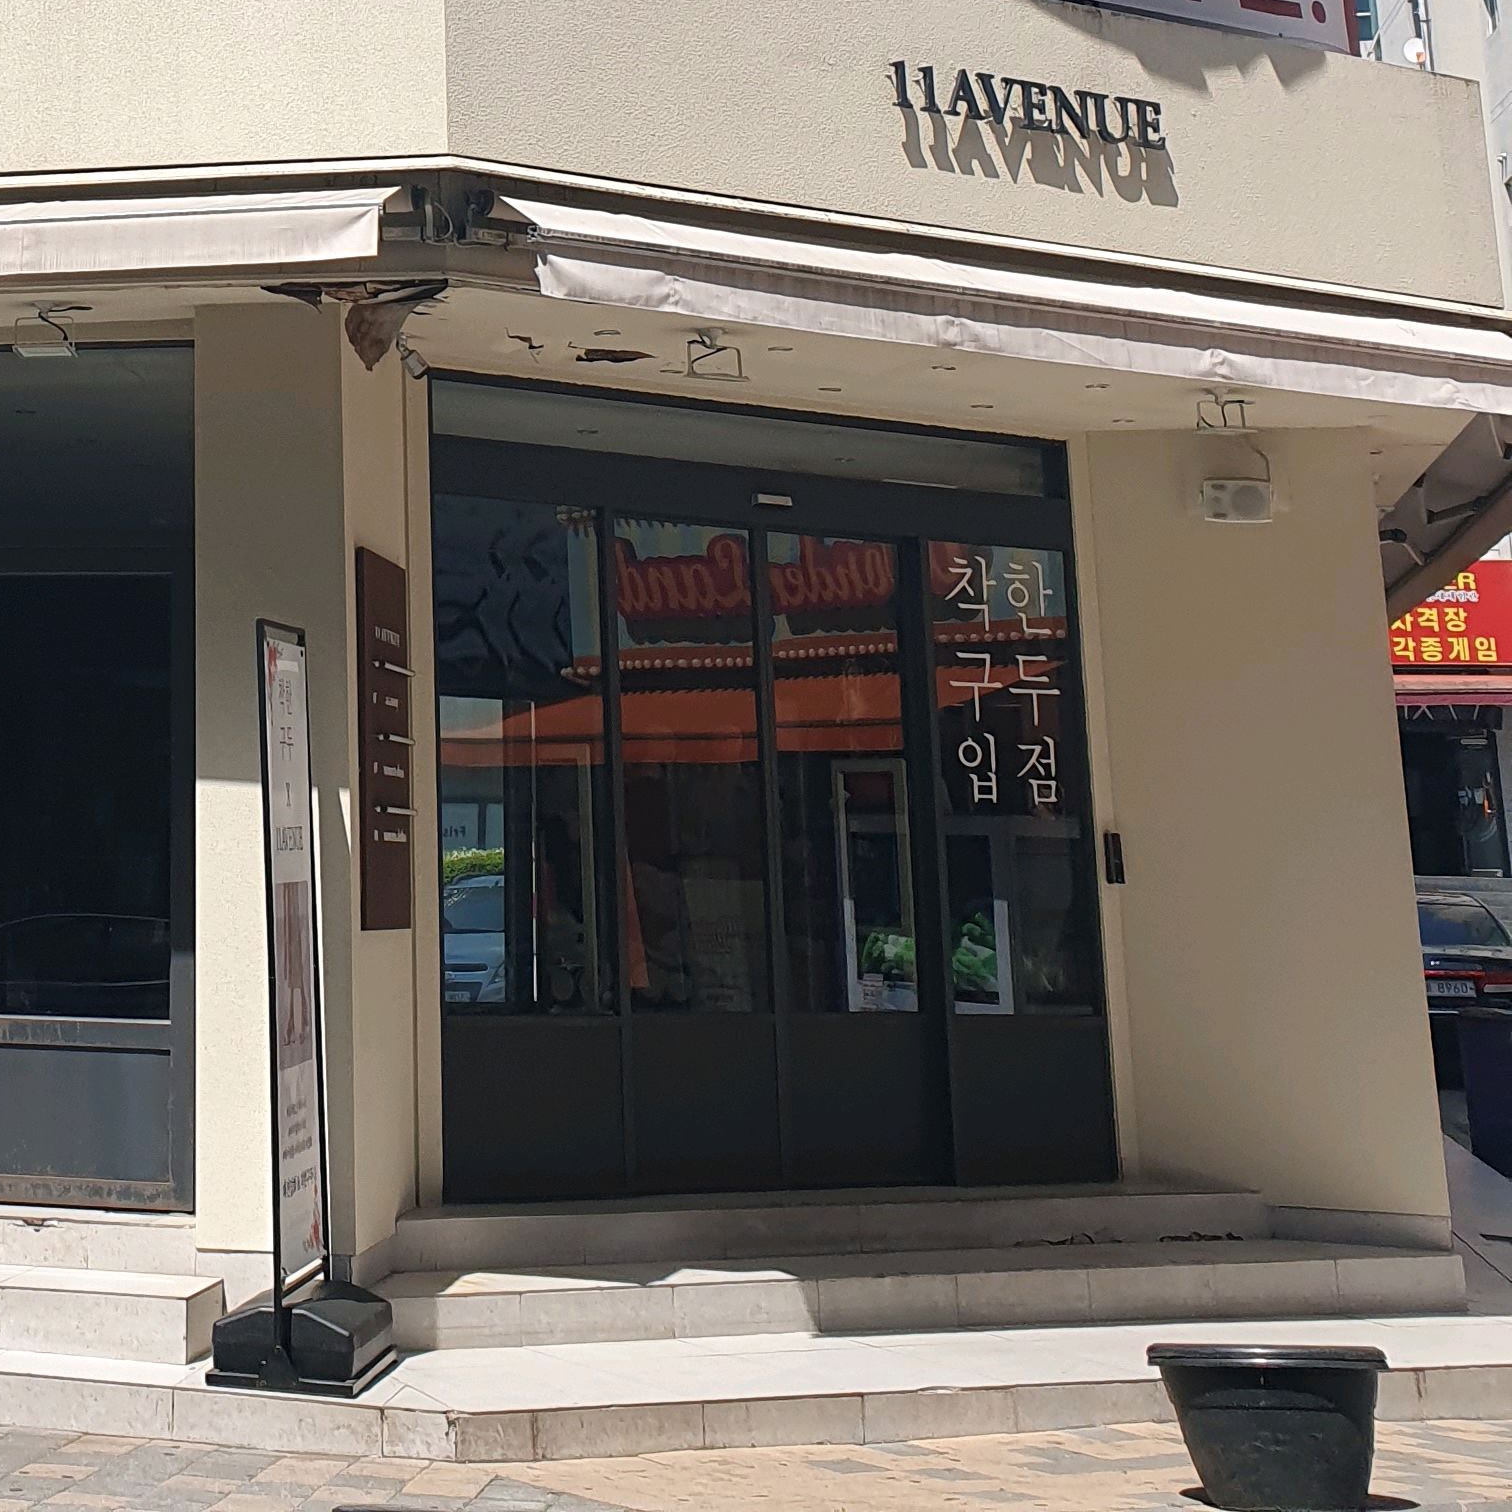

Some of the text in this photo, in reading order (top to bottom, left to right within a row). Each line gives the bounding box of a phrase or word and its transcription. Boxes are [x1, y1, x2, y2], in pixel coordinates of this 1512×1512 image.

[887, 58, 1167, 152] 11AVENUE
[944, 555, 1054, 635] 착한
[949, 651, 1062, 727] 구두
[957, 732, 1059, 807] 입점
